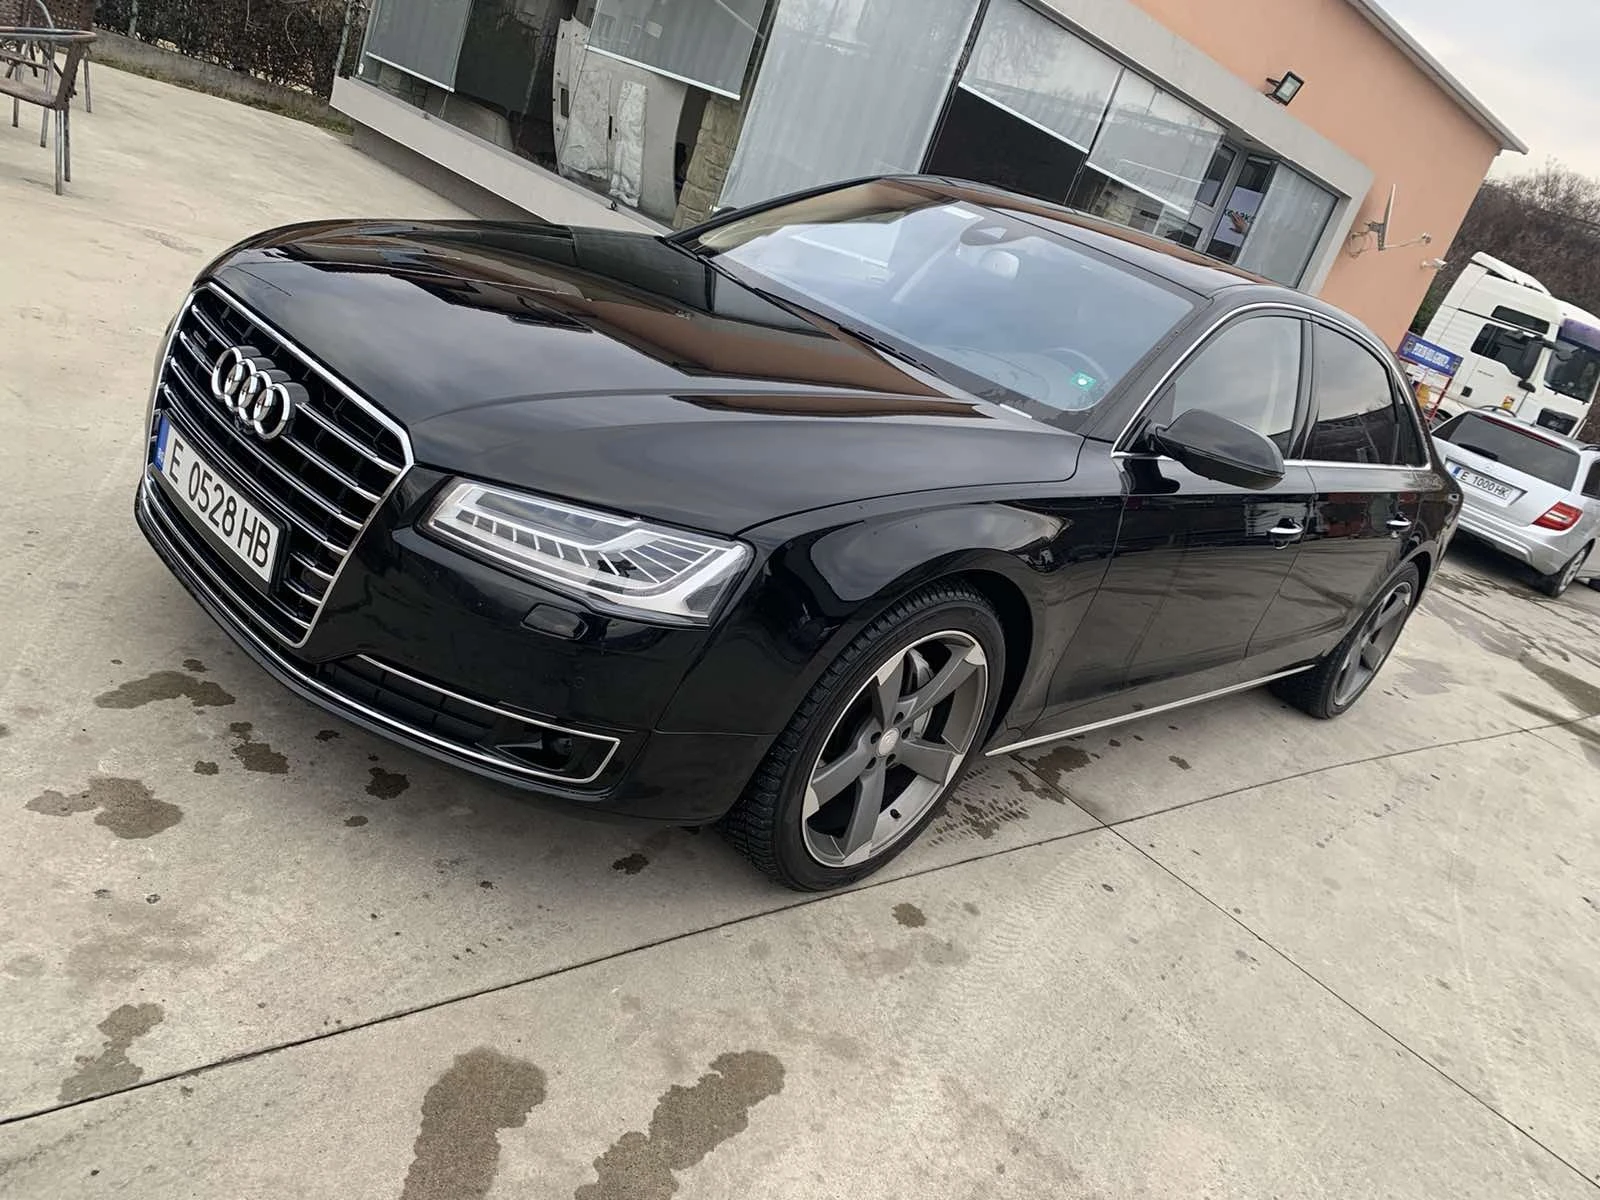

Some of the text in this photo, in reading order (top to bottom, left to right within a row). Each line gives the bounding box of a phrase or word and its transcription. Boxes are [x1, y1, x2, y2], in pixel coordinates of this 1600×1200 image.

[169, 438, 271, 568] E 0528 HB
[1460, 471, 1509, 497] E 1000 HK
